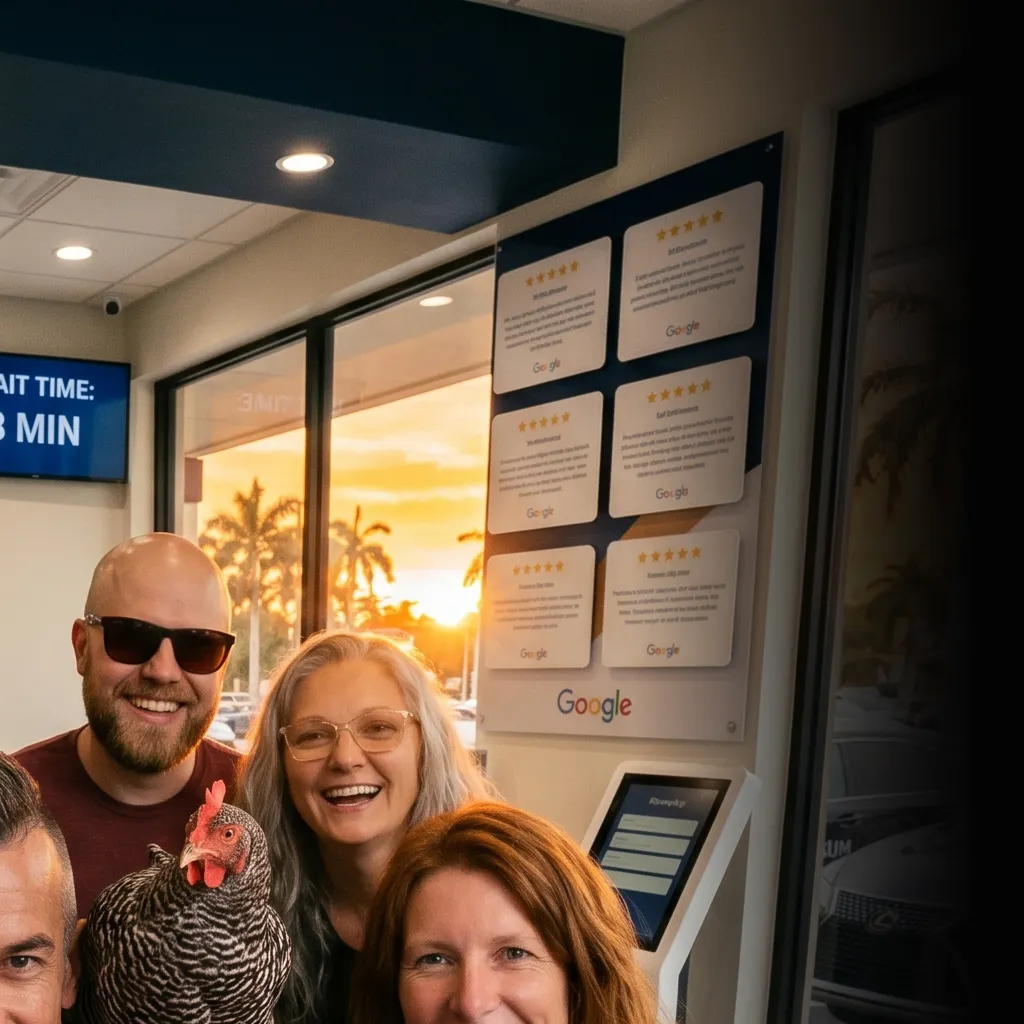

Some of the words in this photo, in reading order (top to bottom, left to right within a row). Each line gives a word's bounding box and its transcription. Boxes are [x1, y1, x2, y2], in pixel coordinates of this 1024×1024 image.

[533, 358, 561, 374] Gogle
[34, 375, 94, 401] TIME:
[16, 412, 80, 447] MIN
[527, 505, 554, 519] Gogle
[557, 688, 632, 724] Google
